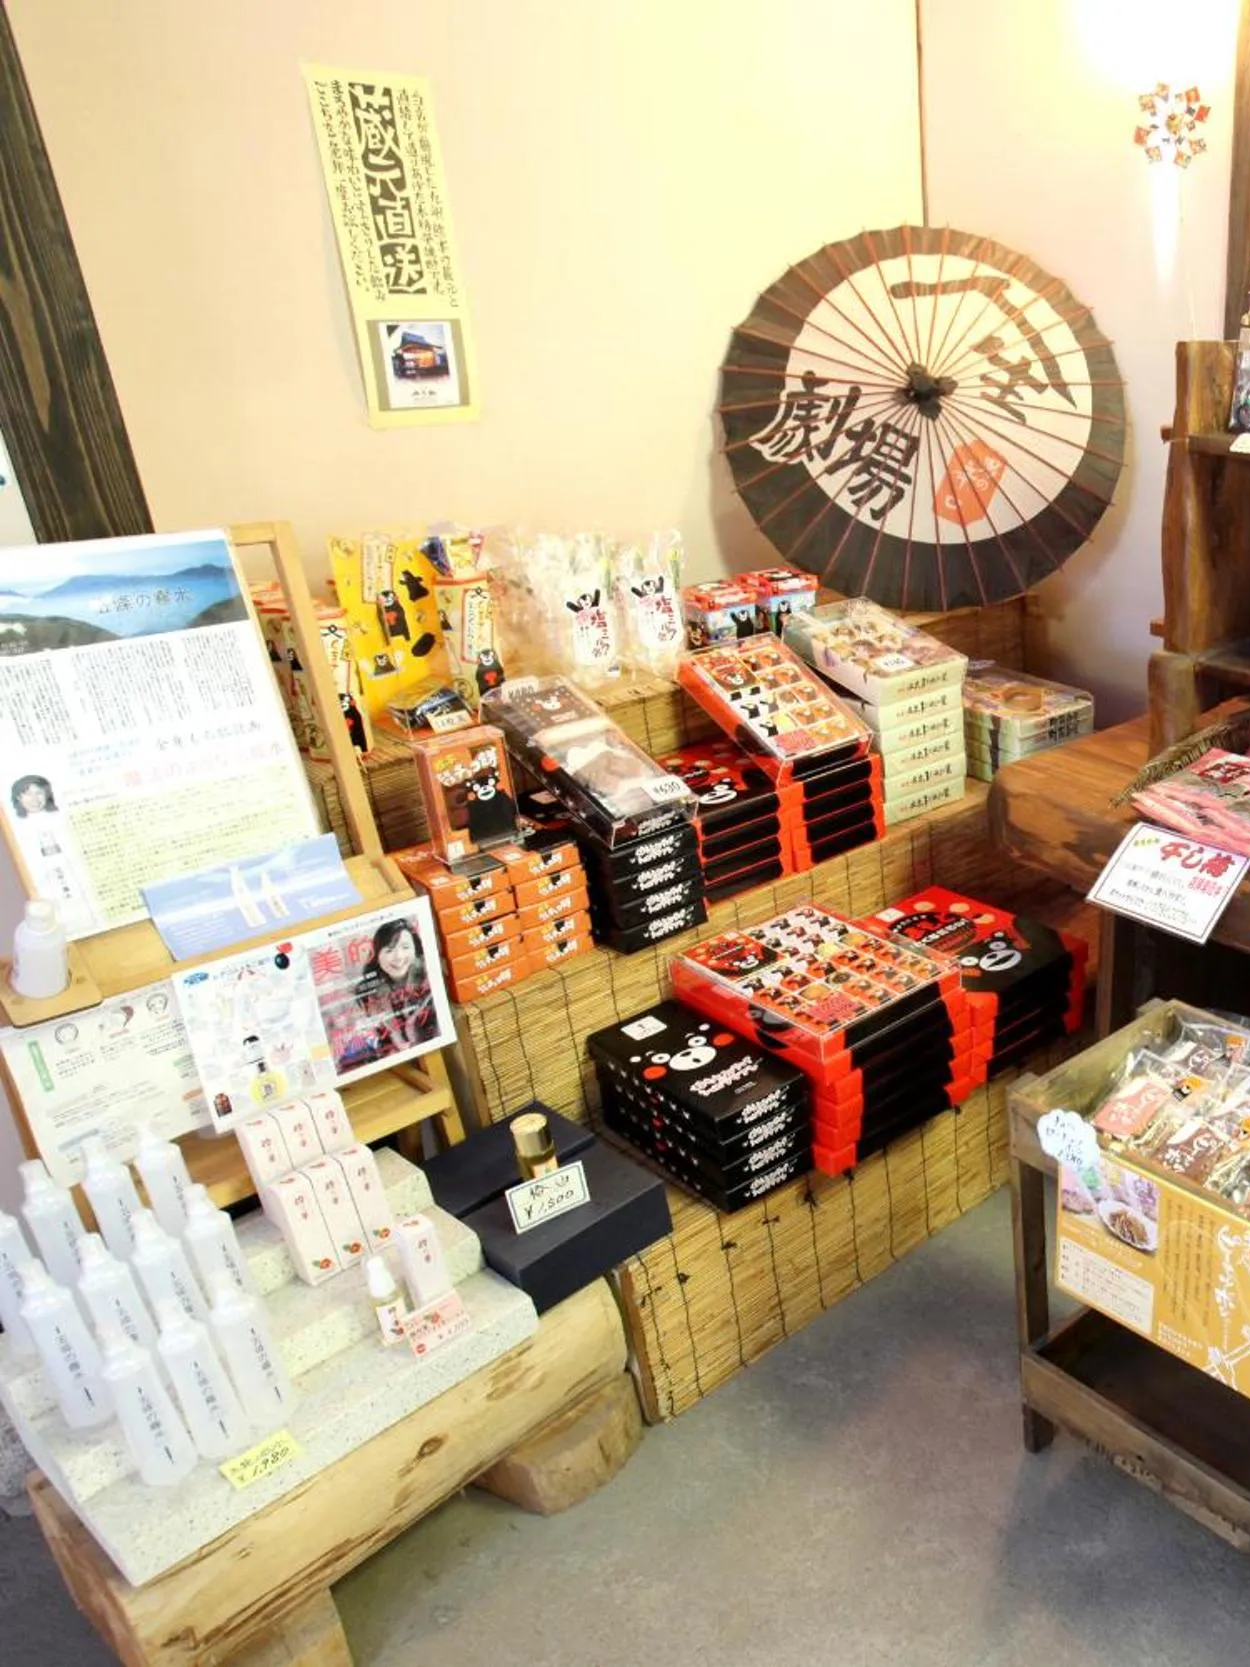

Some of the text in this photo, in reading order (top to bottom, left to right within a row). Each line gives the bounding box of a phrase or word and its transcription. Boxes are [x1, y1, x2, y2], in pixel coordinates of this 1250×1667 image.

[750, 370, 920, 521] 劇場
[1160, 841, 1235, 878] 干し梅
